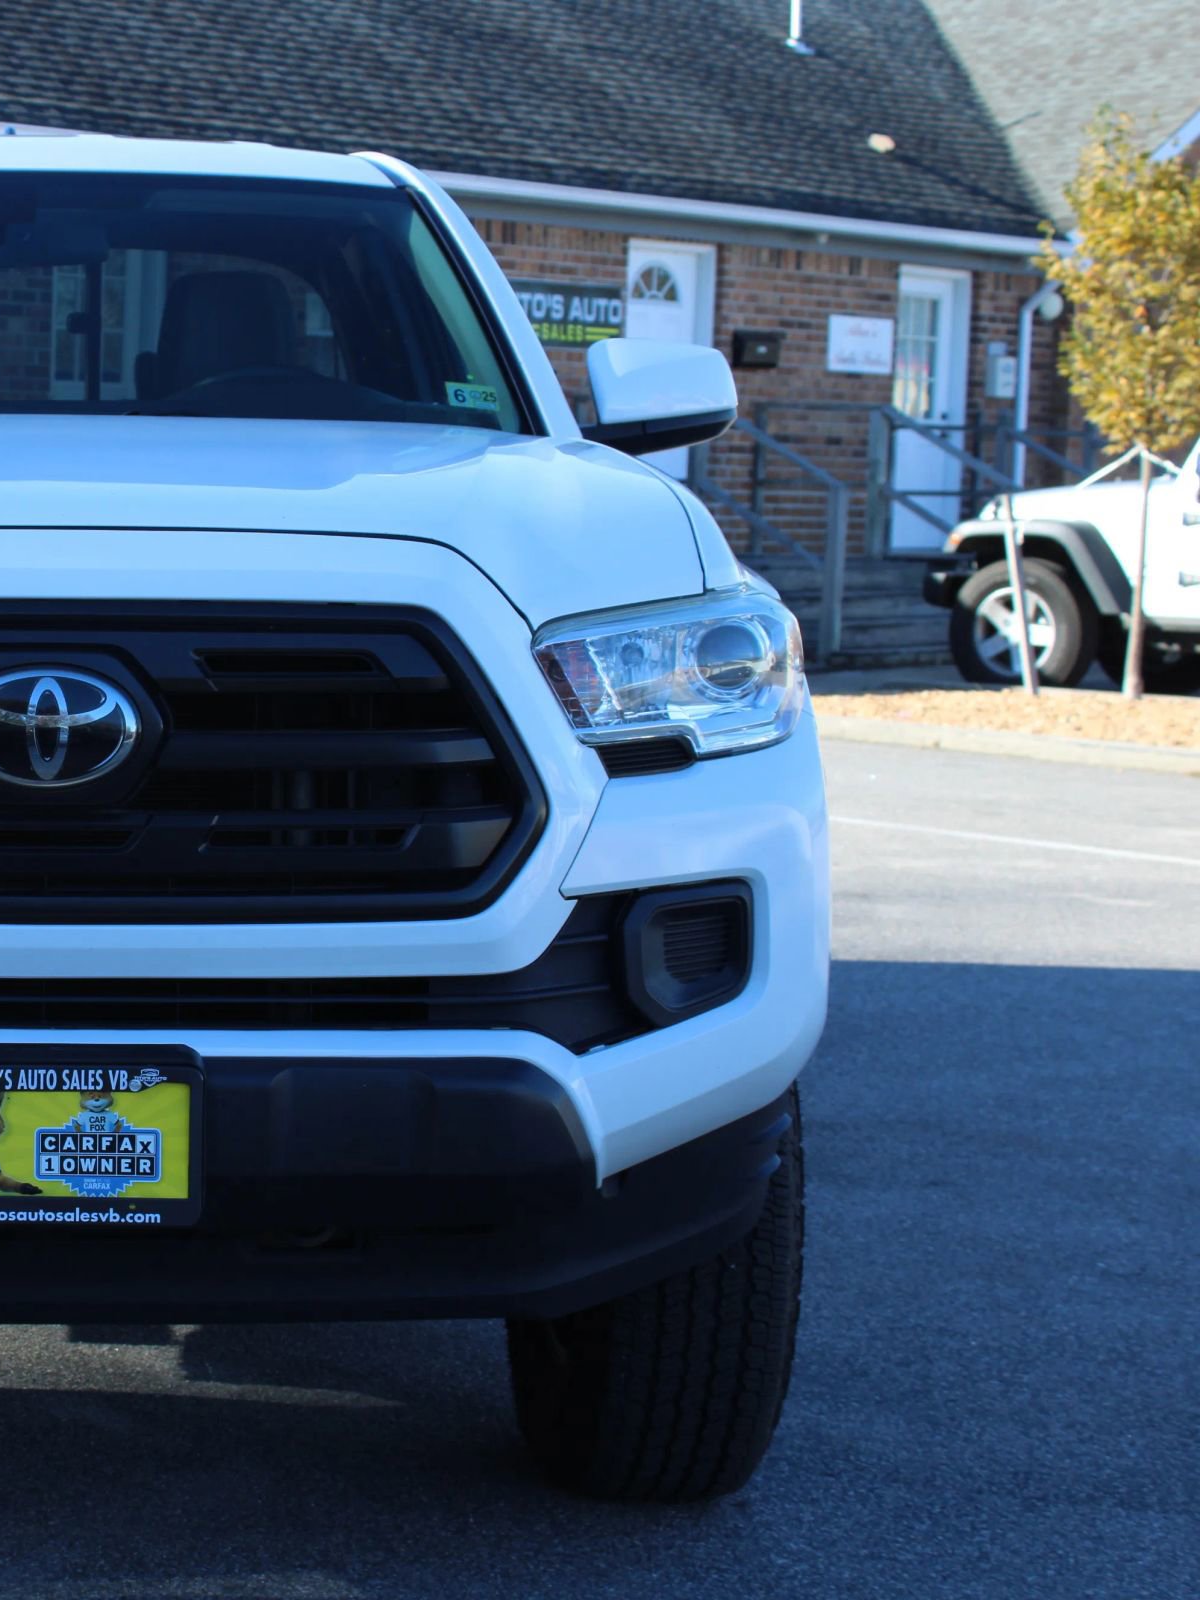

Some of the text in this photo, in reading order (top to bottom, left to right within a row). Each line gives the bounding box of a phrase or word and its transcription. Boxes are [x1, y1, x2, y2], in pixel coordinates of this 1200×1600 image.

[516, 292, 624, 324] TO'S AUTO
[542, 323, 584, 341] SALES
[454, 388, 497, 403] 6 25
[17, 1069, 58, 1090] AUTO
[62, 1069, 104, 1090] SALES
[108, 1069, 128, 1090] VB
[44, 1136, 152, 1153] CARFAX
[44, 1157, 151, 1173] 1 OWNER
[83, 1182, 111, 1190] CARFAX
